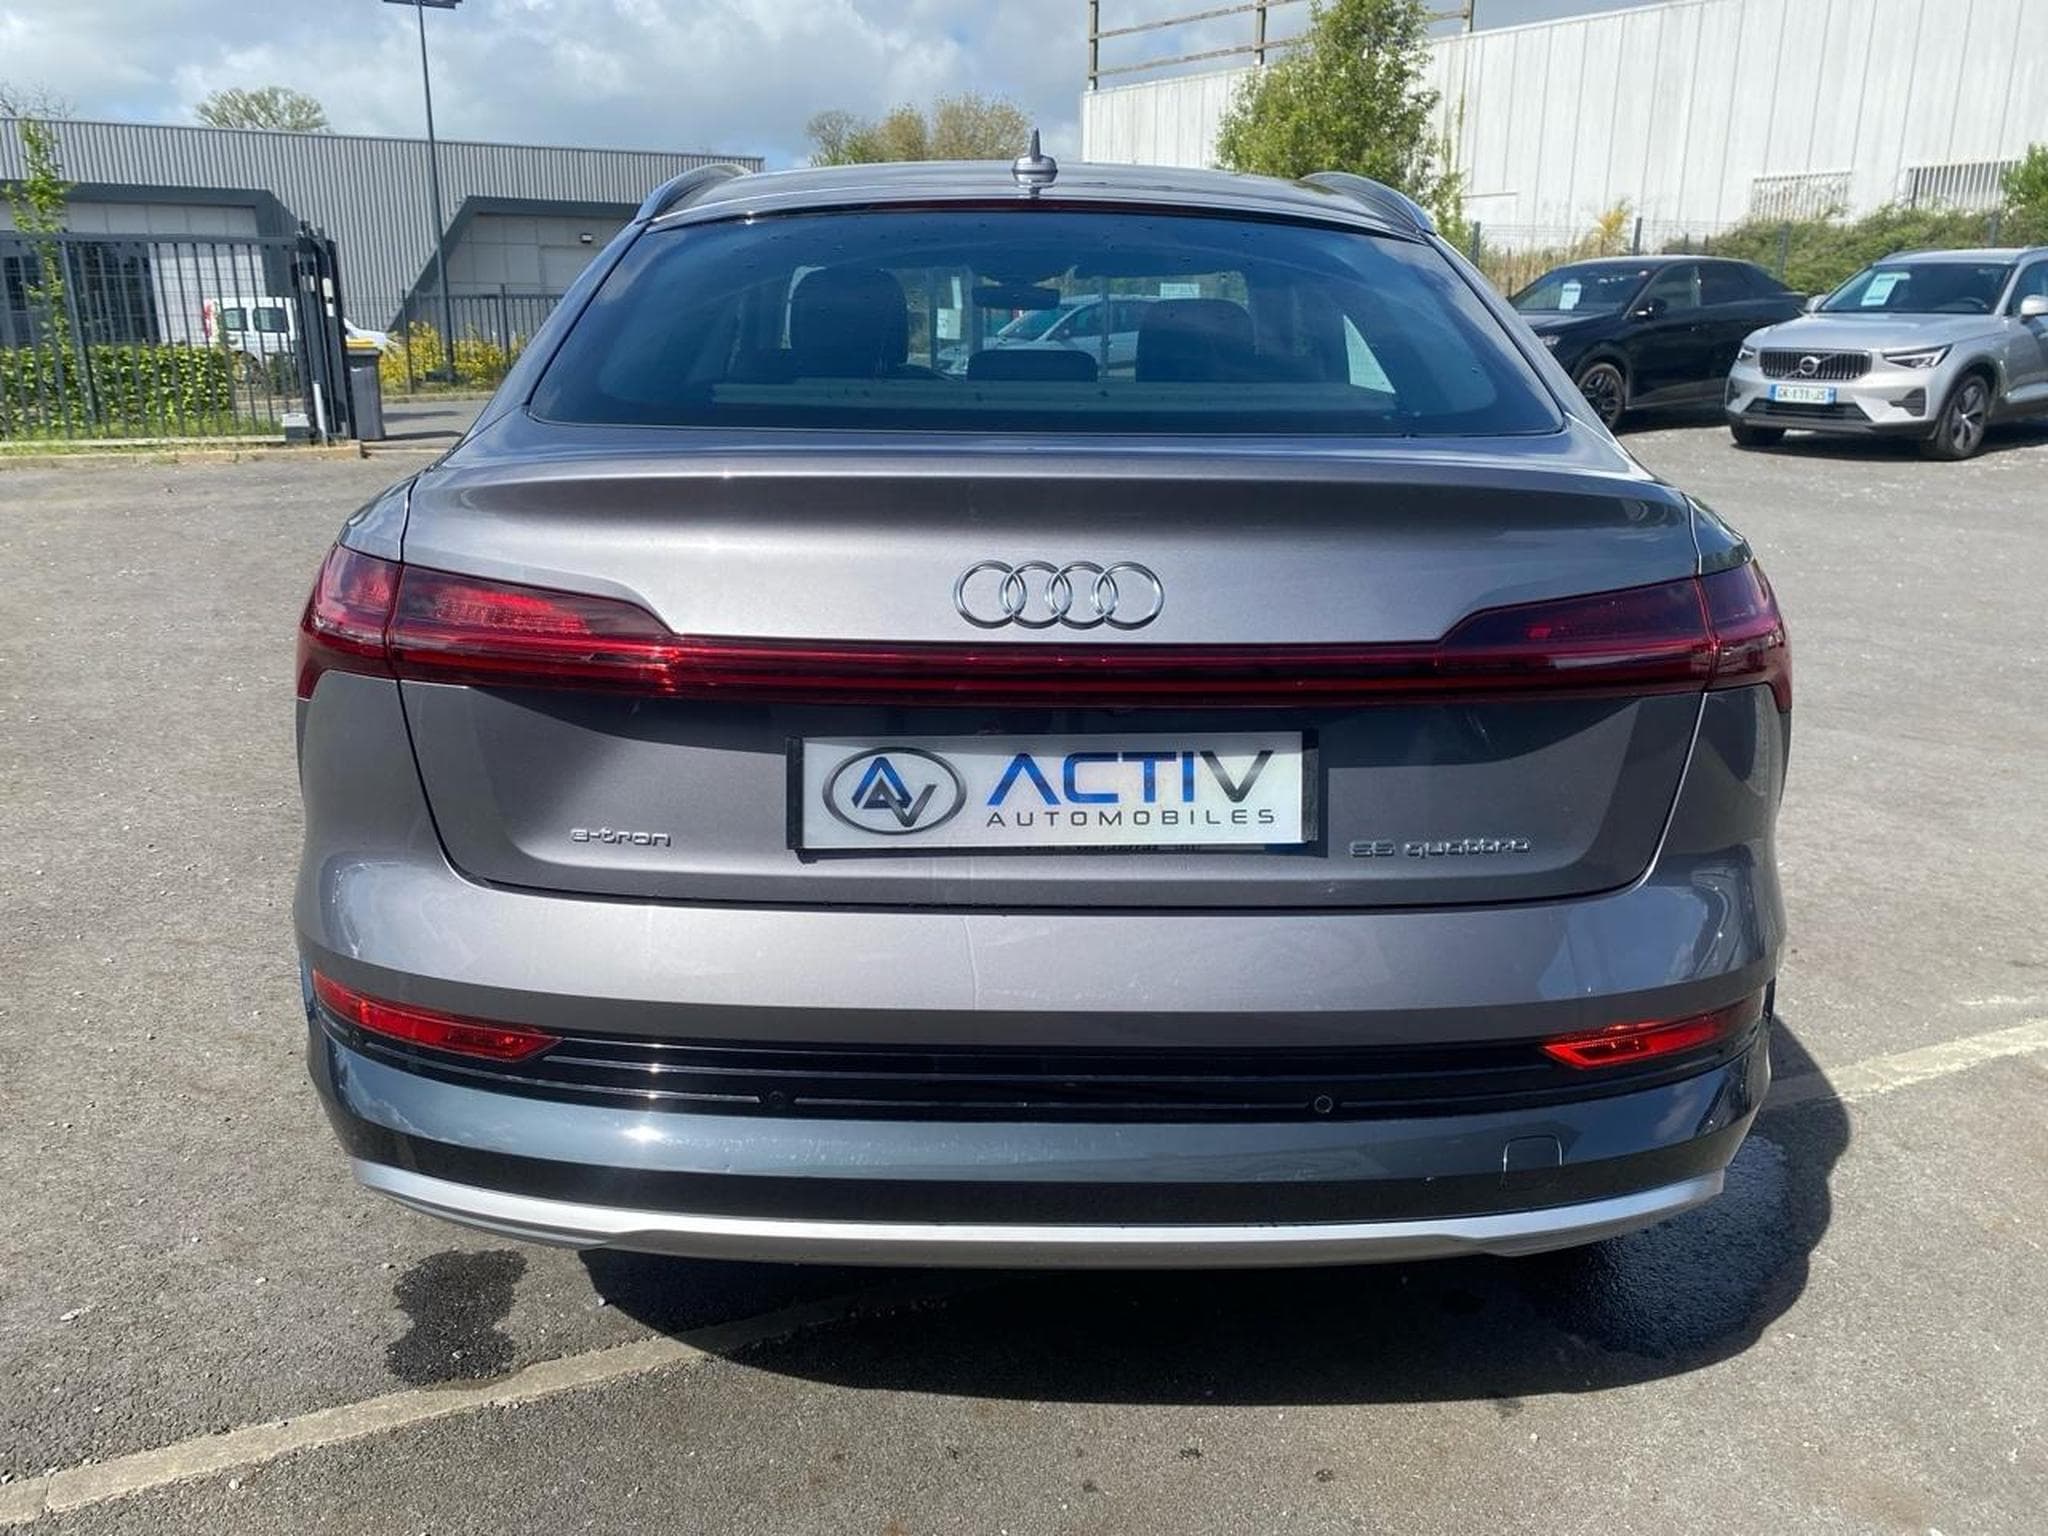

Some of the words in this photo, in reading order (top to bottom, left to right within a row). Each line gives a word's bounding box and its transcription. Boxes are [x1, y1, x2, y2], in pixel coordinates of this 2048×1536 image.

[986, 750, 1274, 806] ACTIV
[986, 809, 1275, 828] AUTOMOBILES
[571, 828, 671, 847] e-tron
[1405, 839, 1530, 859] quattro
